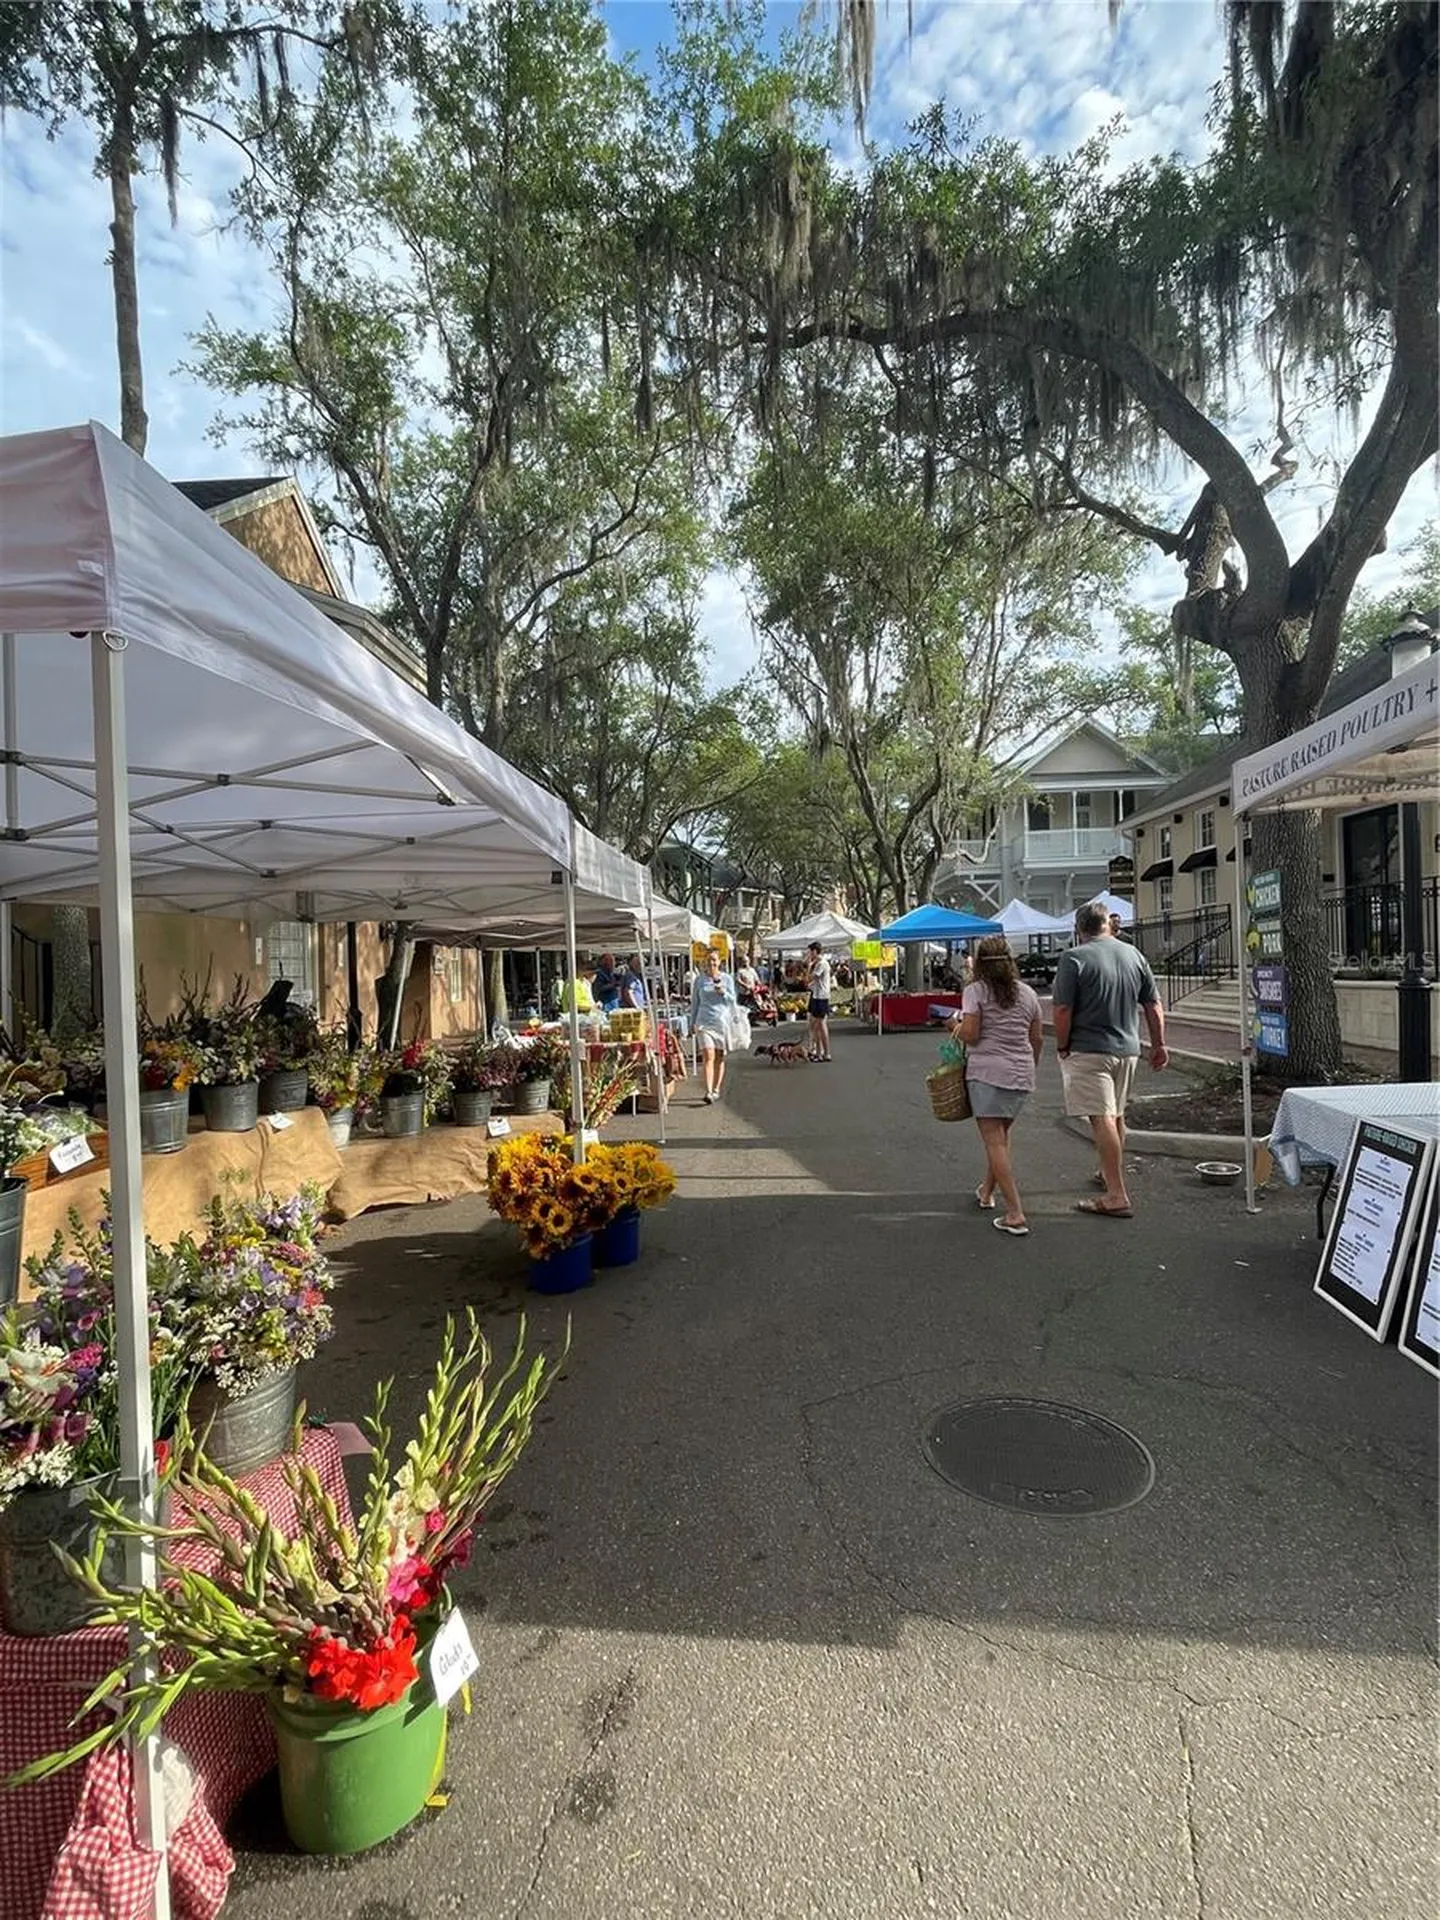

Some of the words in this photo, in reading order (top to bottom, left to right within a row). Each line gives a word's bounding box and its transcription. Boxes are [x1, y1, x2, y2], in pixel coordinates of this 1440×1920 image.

[1242, 757, 1292, 797] PASTURE
[1291, 729, 1338, 772] RAISED
[1339, 683, 1419, 747] POULTRY
